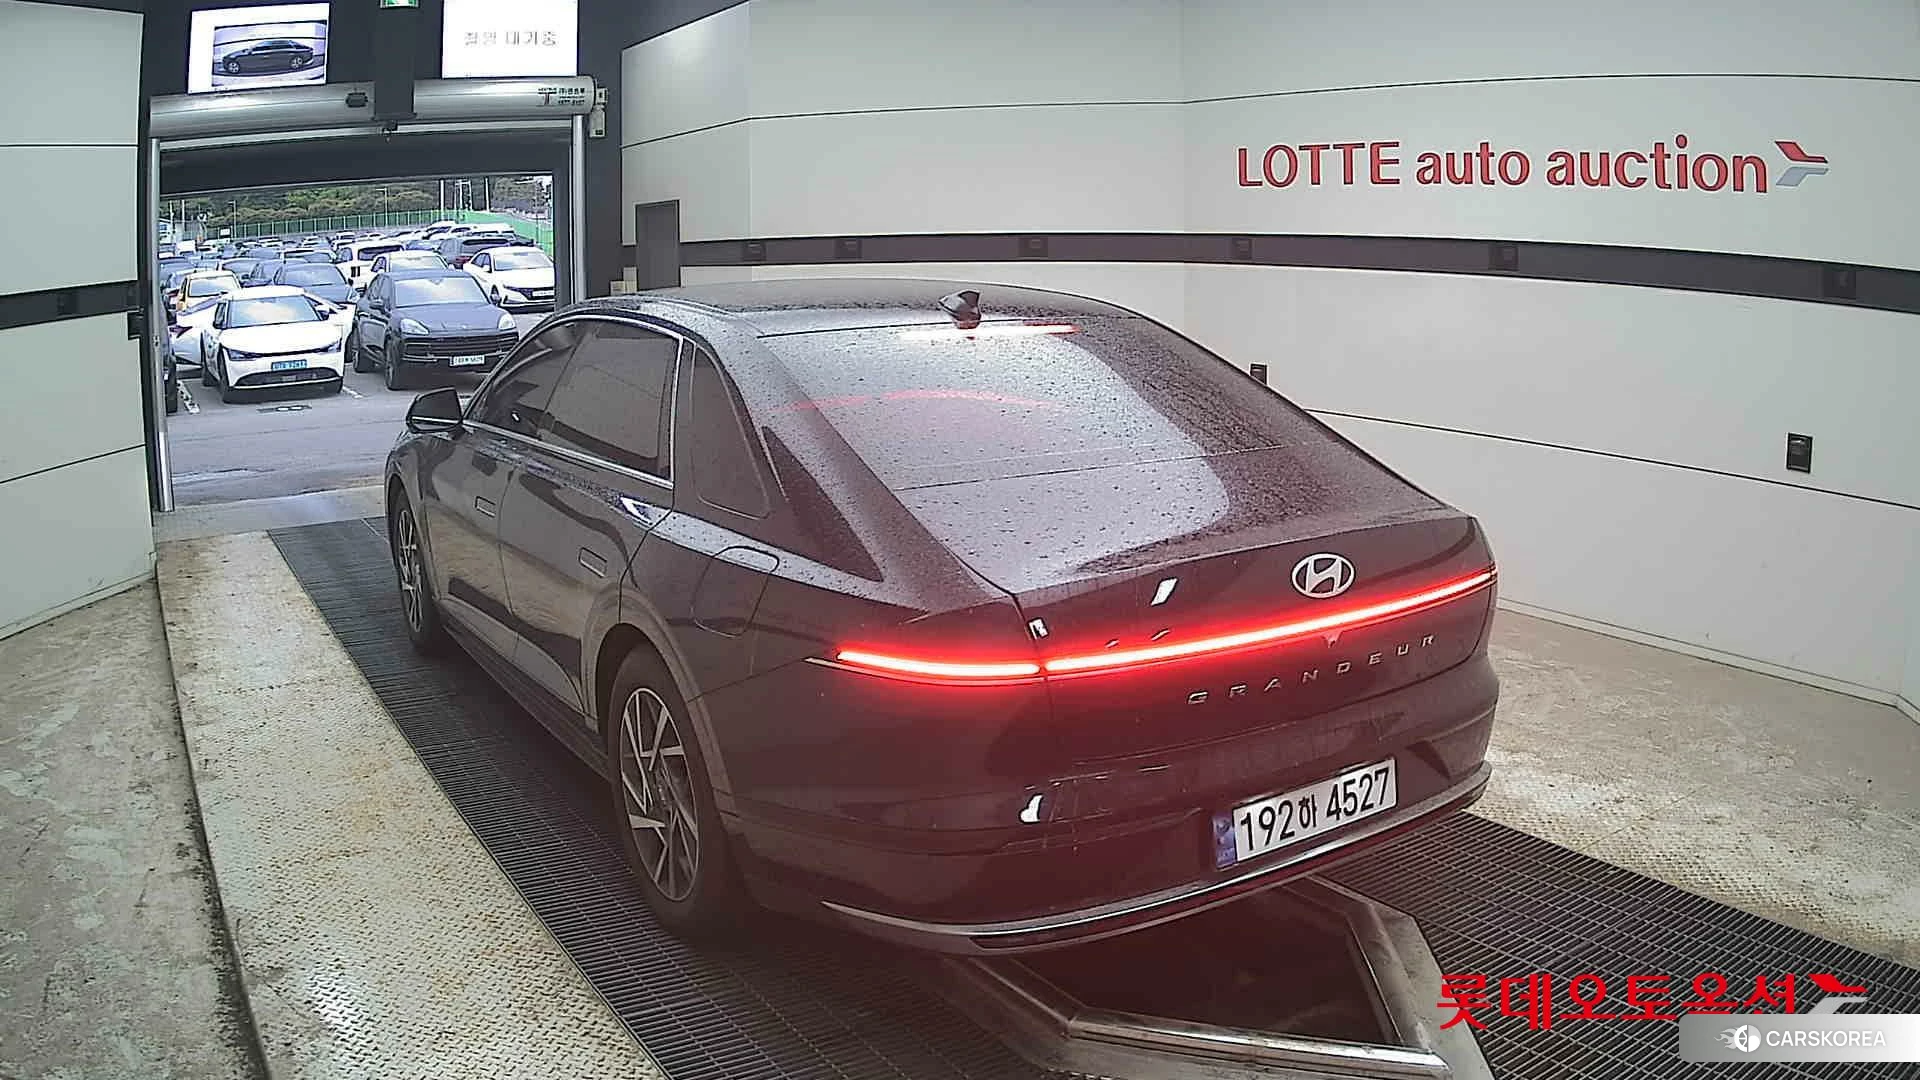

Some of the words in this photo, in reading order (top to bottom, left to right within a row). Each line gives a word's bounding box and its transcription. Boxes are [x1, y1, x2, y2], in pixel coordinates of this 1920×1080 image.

[1236, 140, 1401, 188] LOTTE
[1415, 141, 1531, 187] auto
[1545, 133, 1768, 194] auction
[1187, 633, 1436, 705] GRANDEUR
[1240, 792, 1318, 852] 192하
[1326, 766, 1390, 821] 4527
